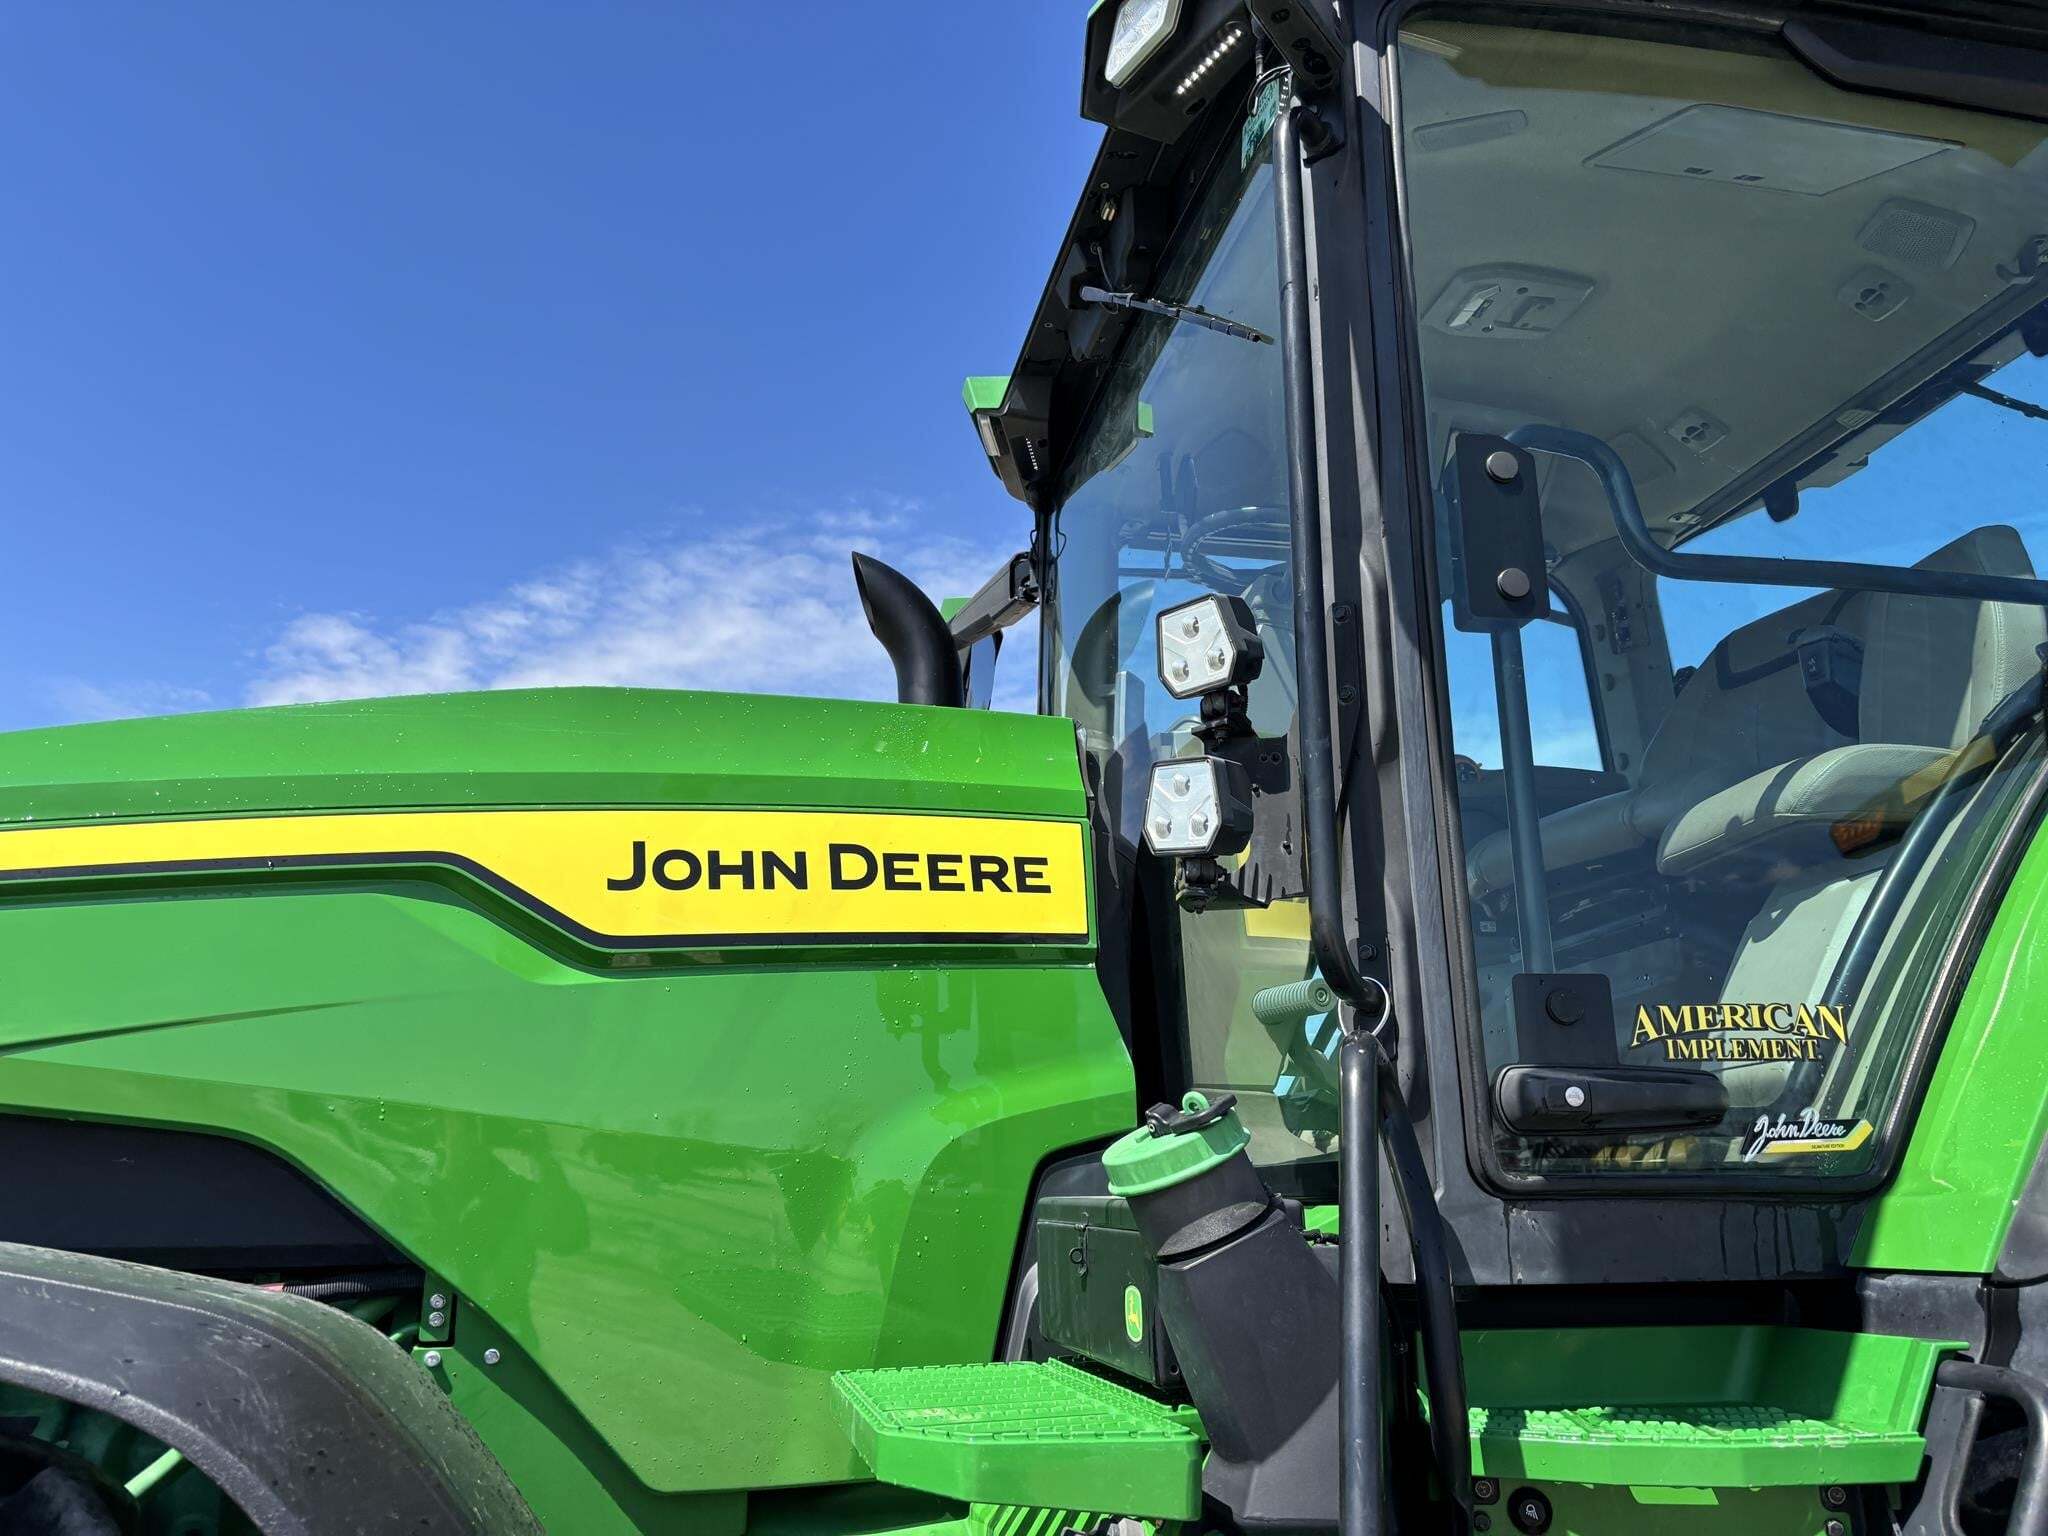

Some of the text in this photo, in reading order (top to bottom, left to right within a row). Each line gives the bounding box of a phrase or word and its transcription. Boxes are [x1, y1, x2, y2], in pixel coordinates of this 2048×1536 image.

[607, 841, 1052, 893] JOHN DEERE
[1631, 1003, 1849, 1047] AMERICAN
[1666, 1038, 1819, 1061] IMPLEMENT
[1744, 1107, 1846, 1162] John Deere
